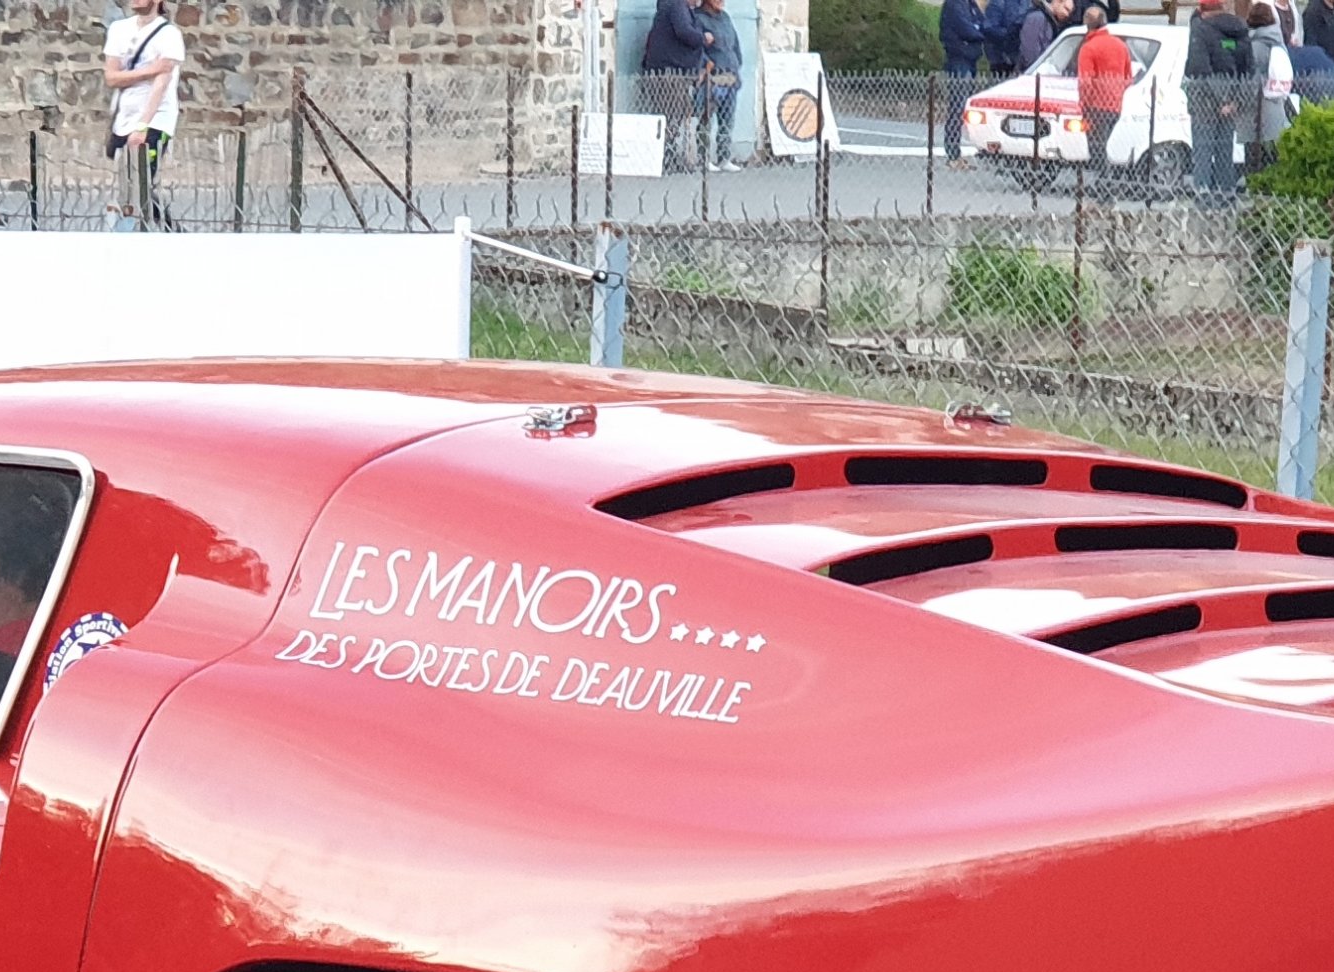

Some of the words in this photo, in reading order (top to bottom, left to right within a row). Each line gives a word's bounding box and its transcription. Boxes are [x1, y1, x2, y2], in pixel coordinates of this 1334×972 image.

[309, 541, 411, 620] LES
[404, 551, 677, 645] MANOIRS
[275, 630, 356, 668] DES
[351, 638, 498, 692] PORTES
[494, 650, 551, 699] DE
[550, 657, 752, 724] DEAUVILLE
